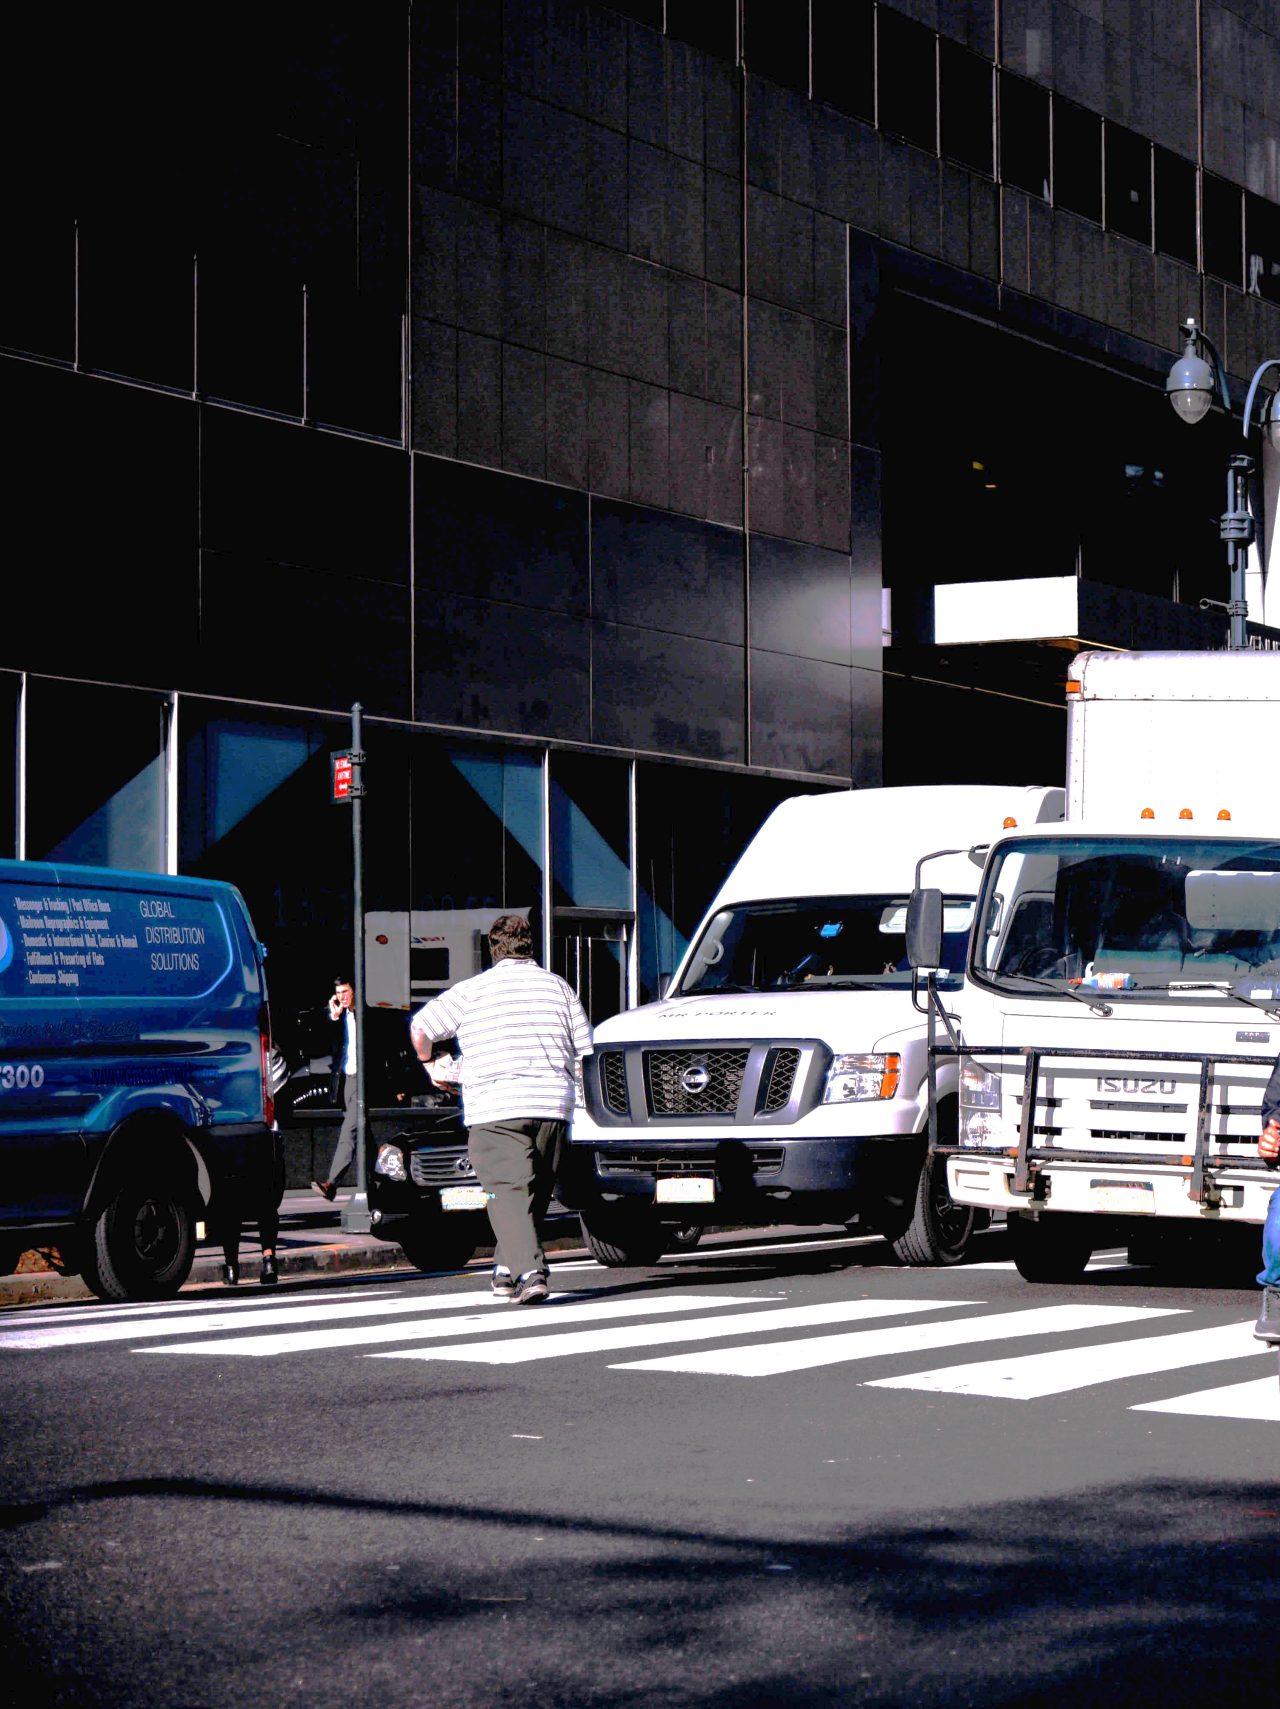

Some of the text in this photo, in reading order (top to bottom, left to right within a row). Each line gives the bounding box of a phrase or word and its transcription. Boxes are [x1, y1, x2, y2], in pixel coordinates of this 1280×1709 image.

[140, 900, 176, 918] GLOBAL
[145, 926, 205, 945] DISTRIBUTION
[150, 953, 200, 971] SOLUTIONS
[0, 1065, 45, 1089] 300
[1097, 1076, 1177, 1095] ISUZU
